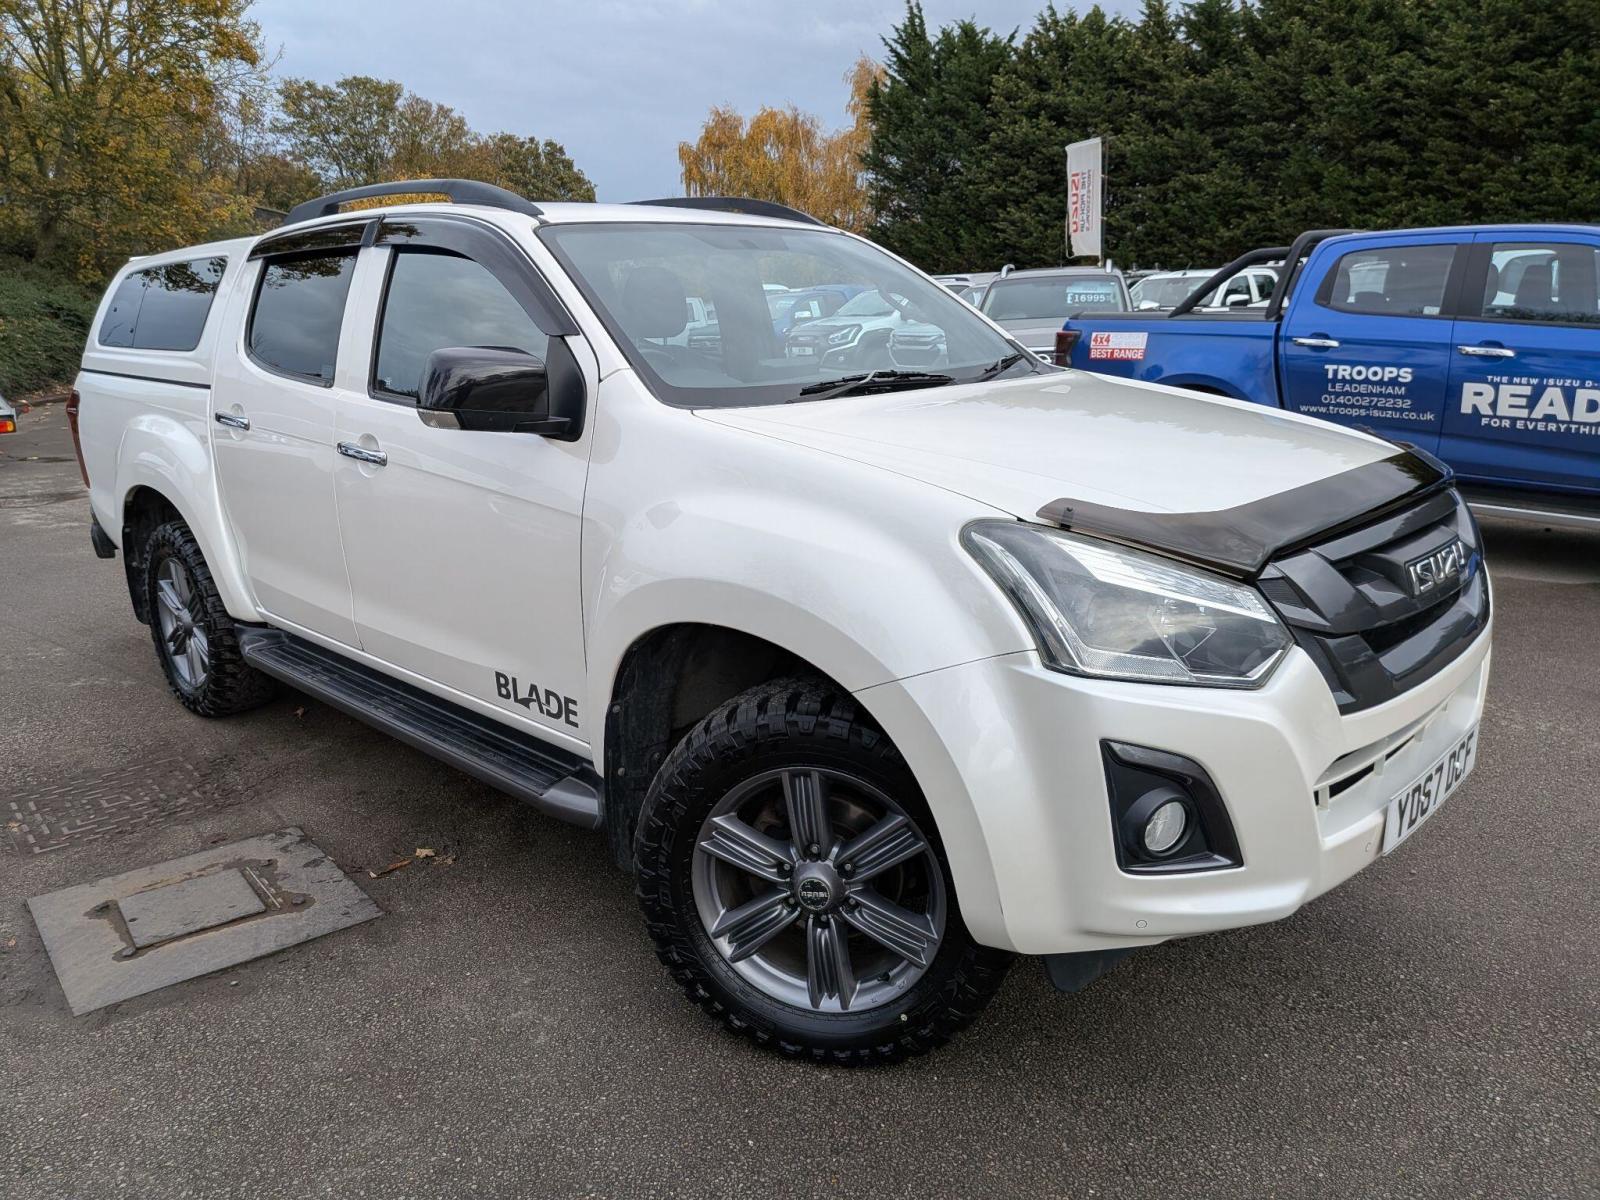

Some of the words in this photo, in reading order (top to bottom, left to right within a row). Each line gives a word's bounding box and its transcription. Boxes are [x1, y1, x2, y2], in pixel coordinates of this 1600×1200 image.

[1091, 349, 1112, 359] BEST
[1113, 349, 1144, 359] RANGE
[1324, 364, 1413, 382] TROOPS
[1487, 375, 1509, 383] THE
[1512, 376, 1539, 385] NEW
[1543, 378, 1580, 387] ISUZU
[1327, 383, 1405, 395] LEADENHAM
[1321, 395, 1412, 409] 01400272232
[1299, 404, 1435, 421] www.troops-isuzu.co.uk
[1481, 417, 1511, 428] FOR
[1515, 420, 1600, 436] EVERYTHI
[1410, 541, 1465, 595] ISUZU
[495, 671, 579, 728] BLADE
